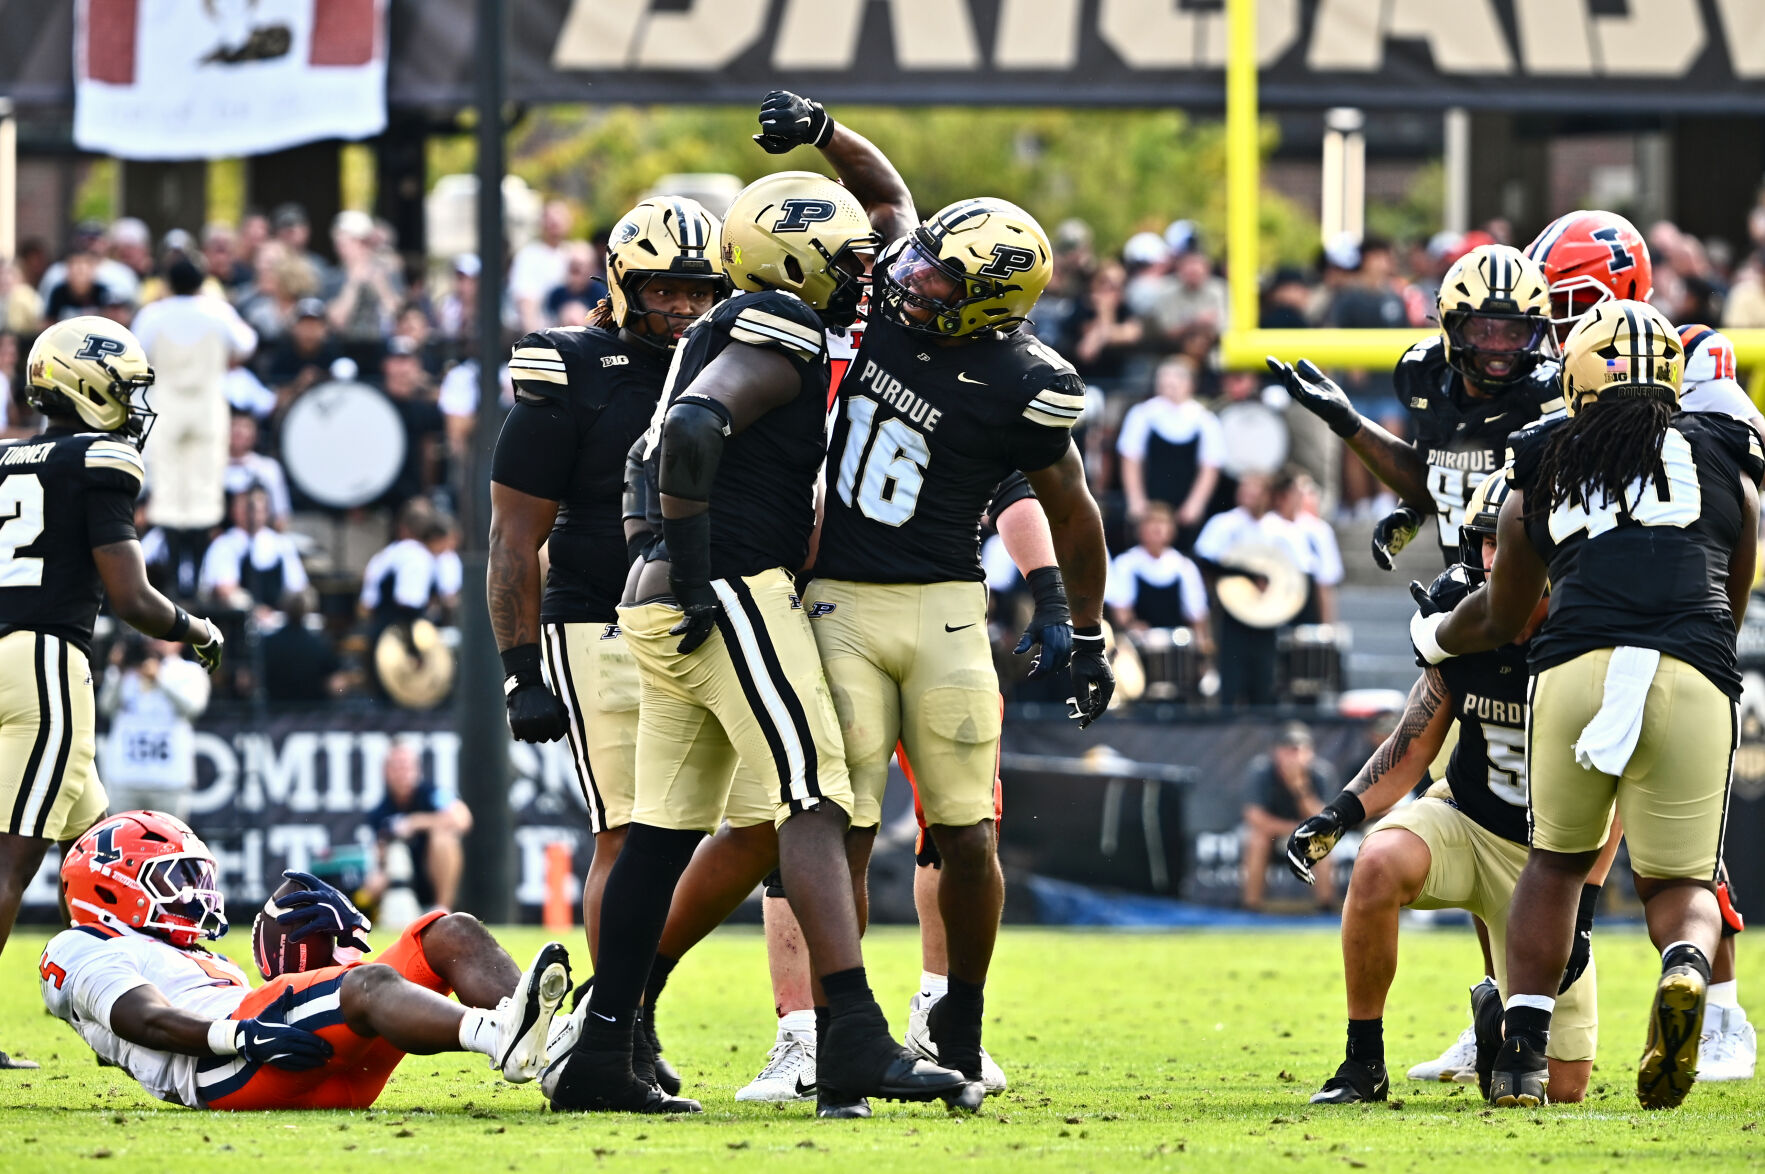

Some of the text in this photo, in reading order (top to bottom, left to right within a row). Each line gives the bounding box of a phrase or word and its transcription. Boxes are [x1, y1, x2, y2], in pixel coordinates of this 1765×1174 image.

[772, 199, 836, 233] P
[976, 243, 1036, 280] P
[1590, 227, 1636, 274] I
[75, 333, 127, 361] P
[860, 360, 944, 432] PURDUE
[0, 442, 56, 466] TURNER
[836, 395, 931, 528] 16
[1426, 449, 1495, 471] PURDUE
[1427, 465, 1489, 547] 9
[0, 473, 44, 587] 2
[808, 601, 836, 618] P
[1463, 693, 1529, 724] PURD
[1480, 722, 1528, 808] 5
[93, 821, 123, 866] I
